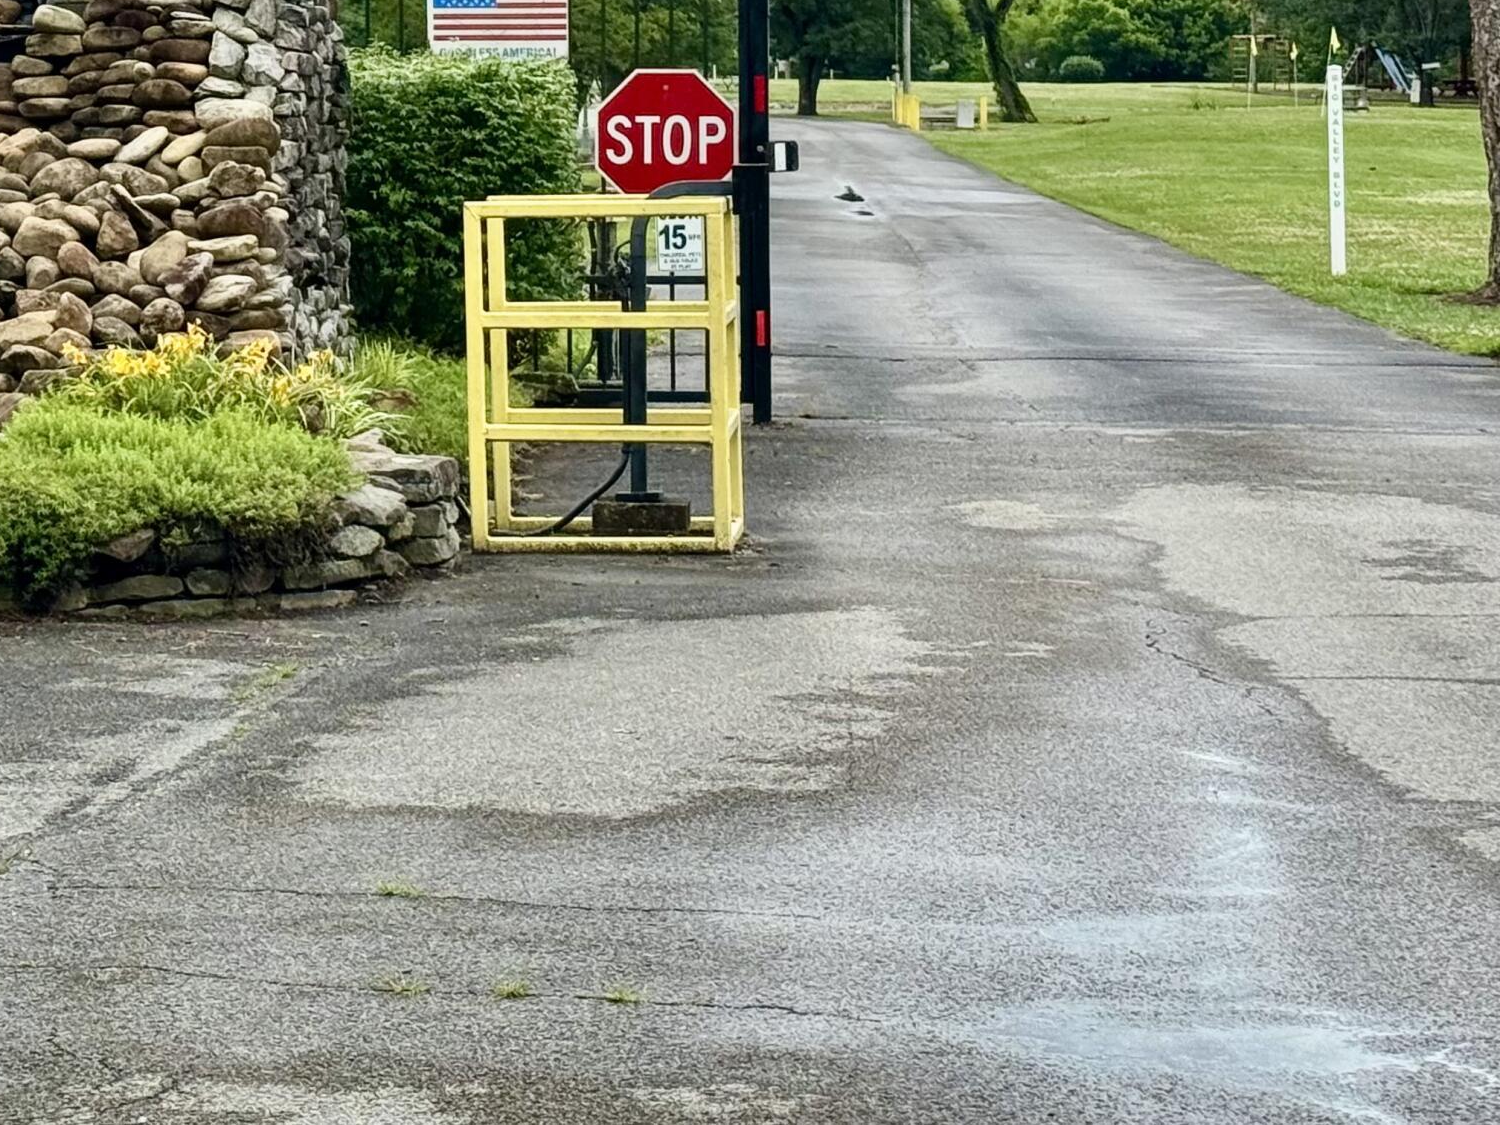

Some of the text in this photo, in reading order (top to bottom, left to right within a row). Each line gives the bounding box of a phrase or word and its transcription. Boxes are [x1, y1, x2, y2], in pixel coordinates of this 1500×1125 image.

[605, 114, 728, 166] STOP
[1332, 107, 1341, 163] VALLEY
[1333, 171, 1342, 208] BLVD
[658, 224, 687, 250] 15
